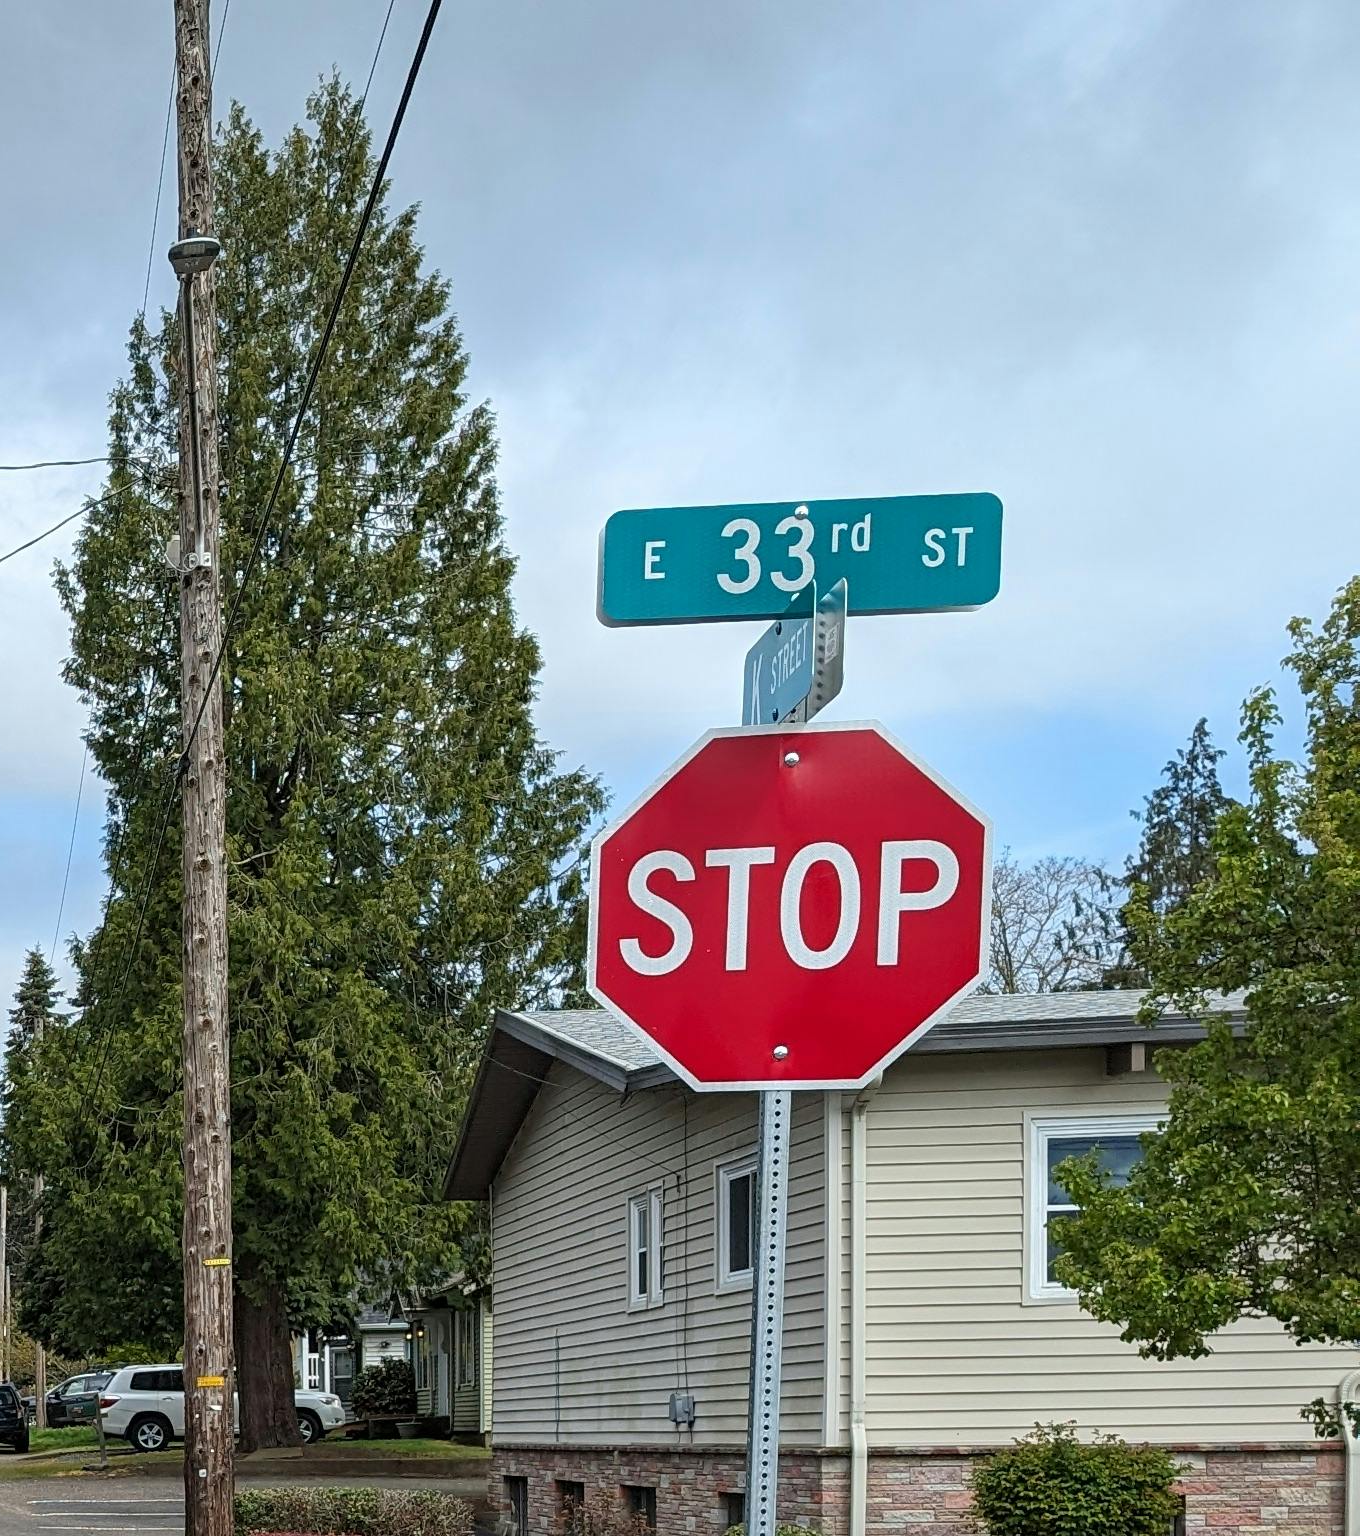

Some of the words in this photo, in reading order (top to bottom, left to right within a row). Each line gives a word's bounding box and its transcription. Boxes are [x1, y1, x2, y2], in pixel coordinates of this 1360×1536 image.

[643, 540, 667, 580] E
[716, 512, 873, 595] 33rd
[921, 526, 974, 568] ST
[770, 620, 809, 695] STREET
[618, 839, 960, 977] STOP
